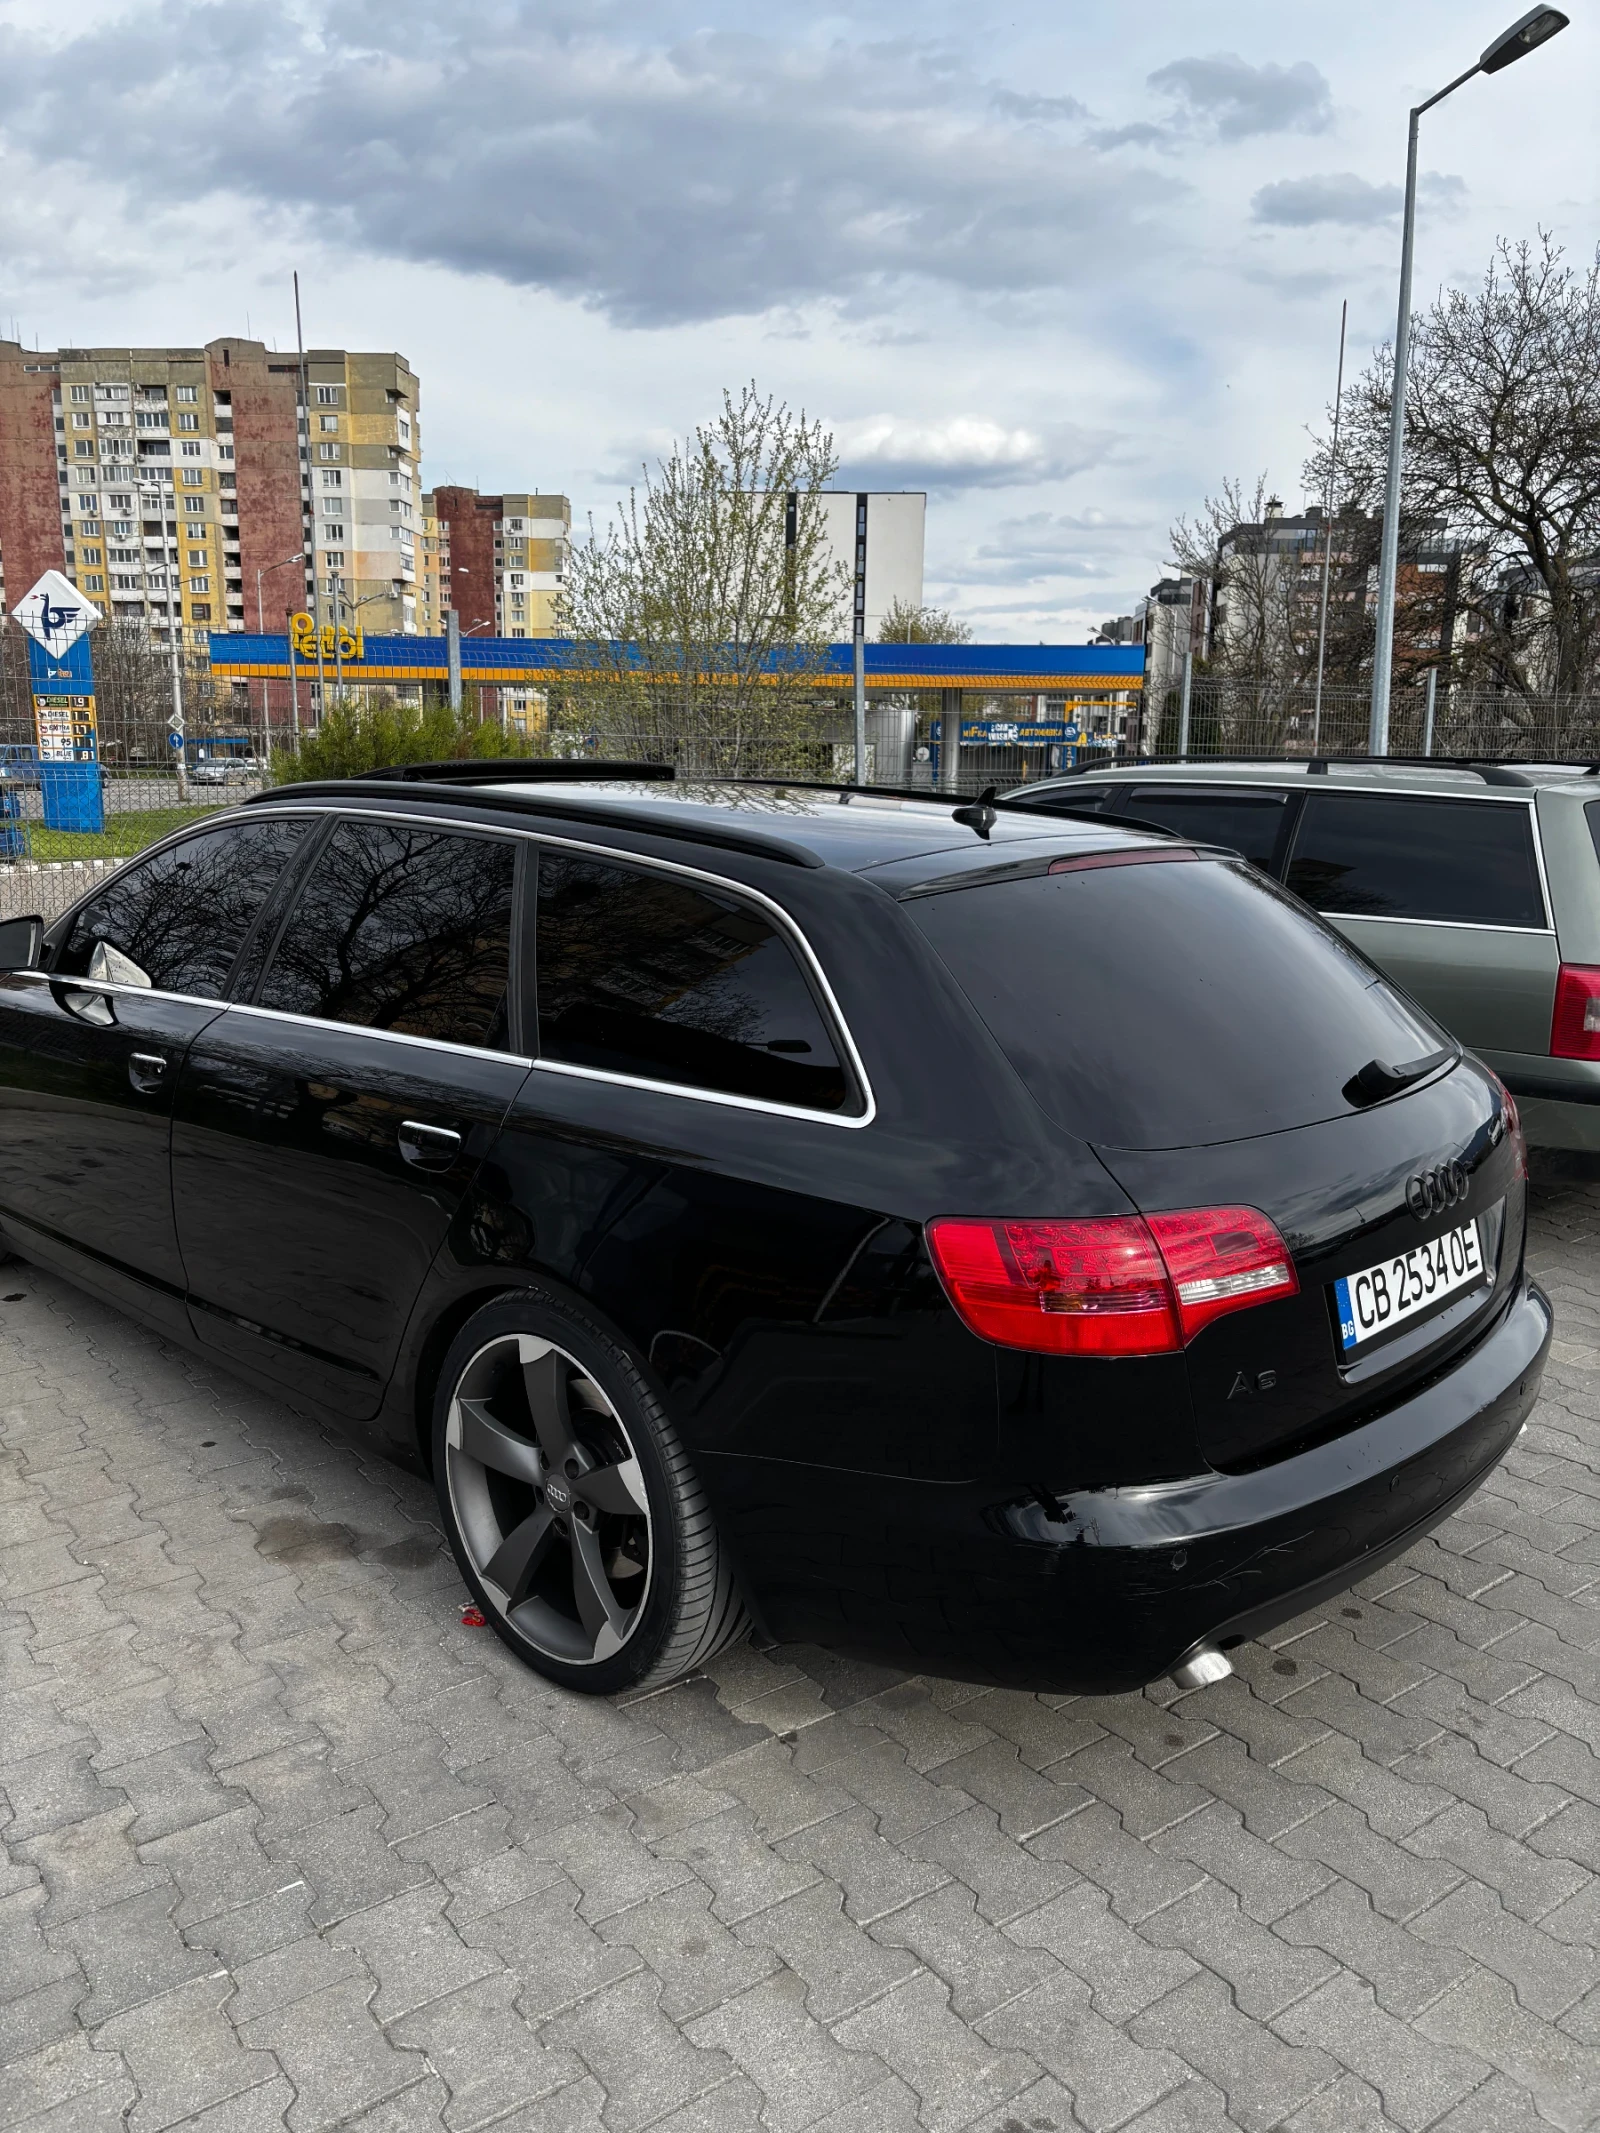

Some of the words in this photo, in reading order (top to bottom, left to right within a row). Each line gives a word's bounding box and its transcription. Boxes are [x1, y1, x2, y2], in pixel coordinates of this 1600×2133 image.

[291, 612, 364, 659] Petrol
[47, 696, 68, 704] DIESEL
[48, 724, 70, 732] EXTRA
[60, 738, 72, 747] 95
[1355, 1268, 1391, 1329] CB
[1393, 1237, 1449, 1311] 2534
[1450, 1221, 1478, 1277] OE
[1341, 1320, 1355, 1340] BG
[1226, 1369, 1277, 1400] A6
